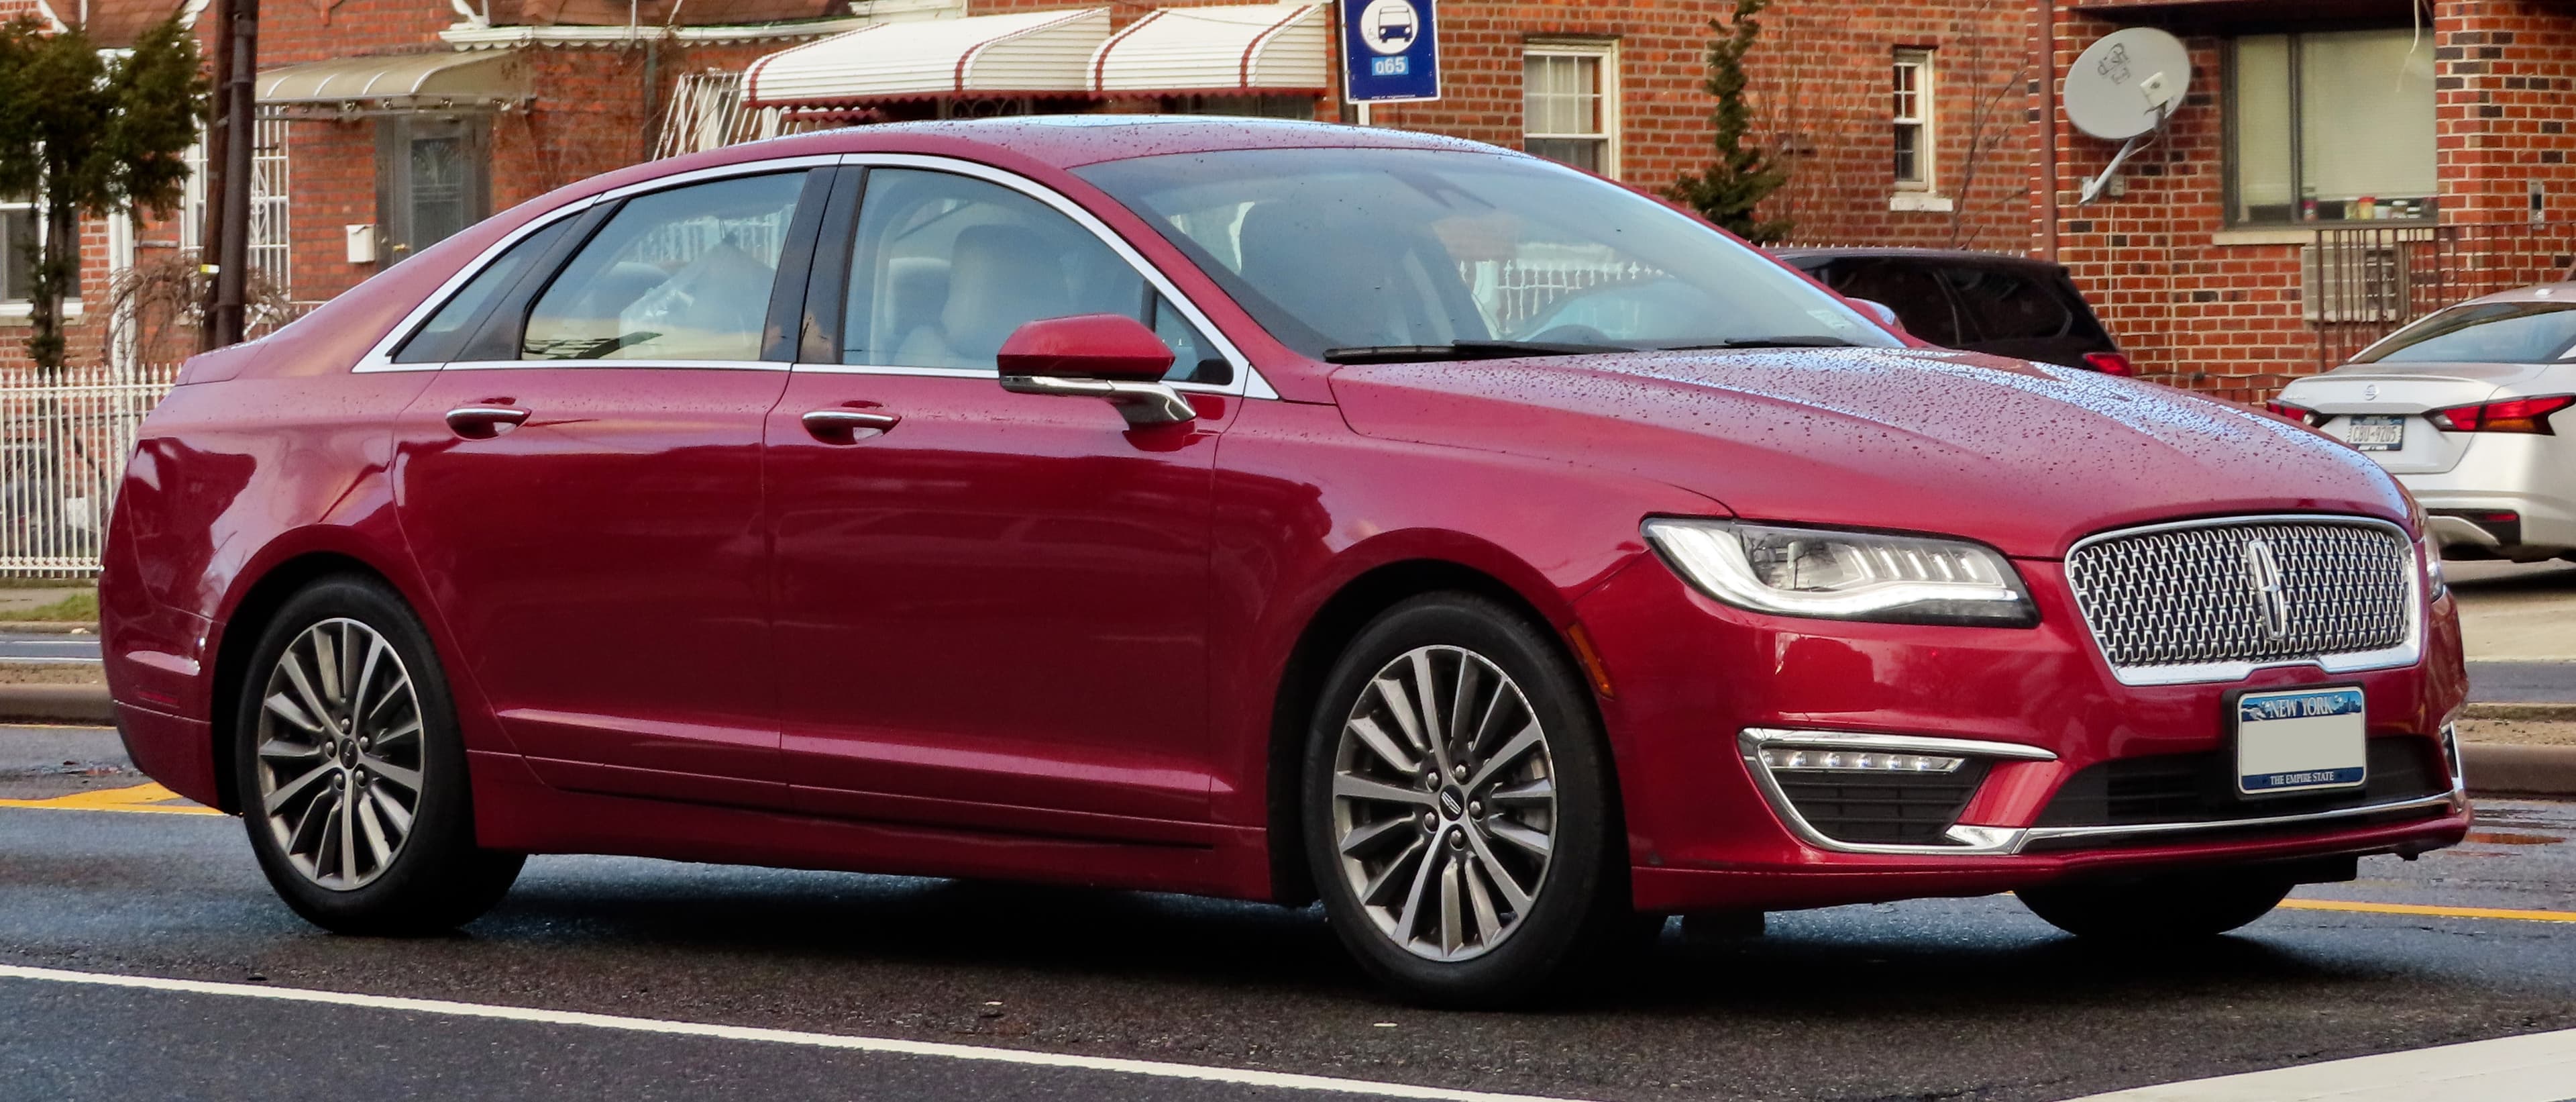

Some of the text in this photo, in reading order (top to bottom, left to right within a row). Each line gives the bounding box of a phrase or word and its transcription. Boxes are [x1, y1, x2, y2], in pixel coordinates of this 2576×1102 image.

[2269, 697, 2333, 718] NEW YORK
[2270, 772, 2334, 785] THE EMPIRE STATE
